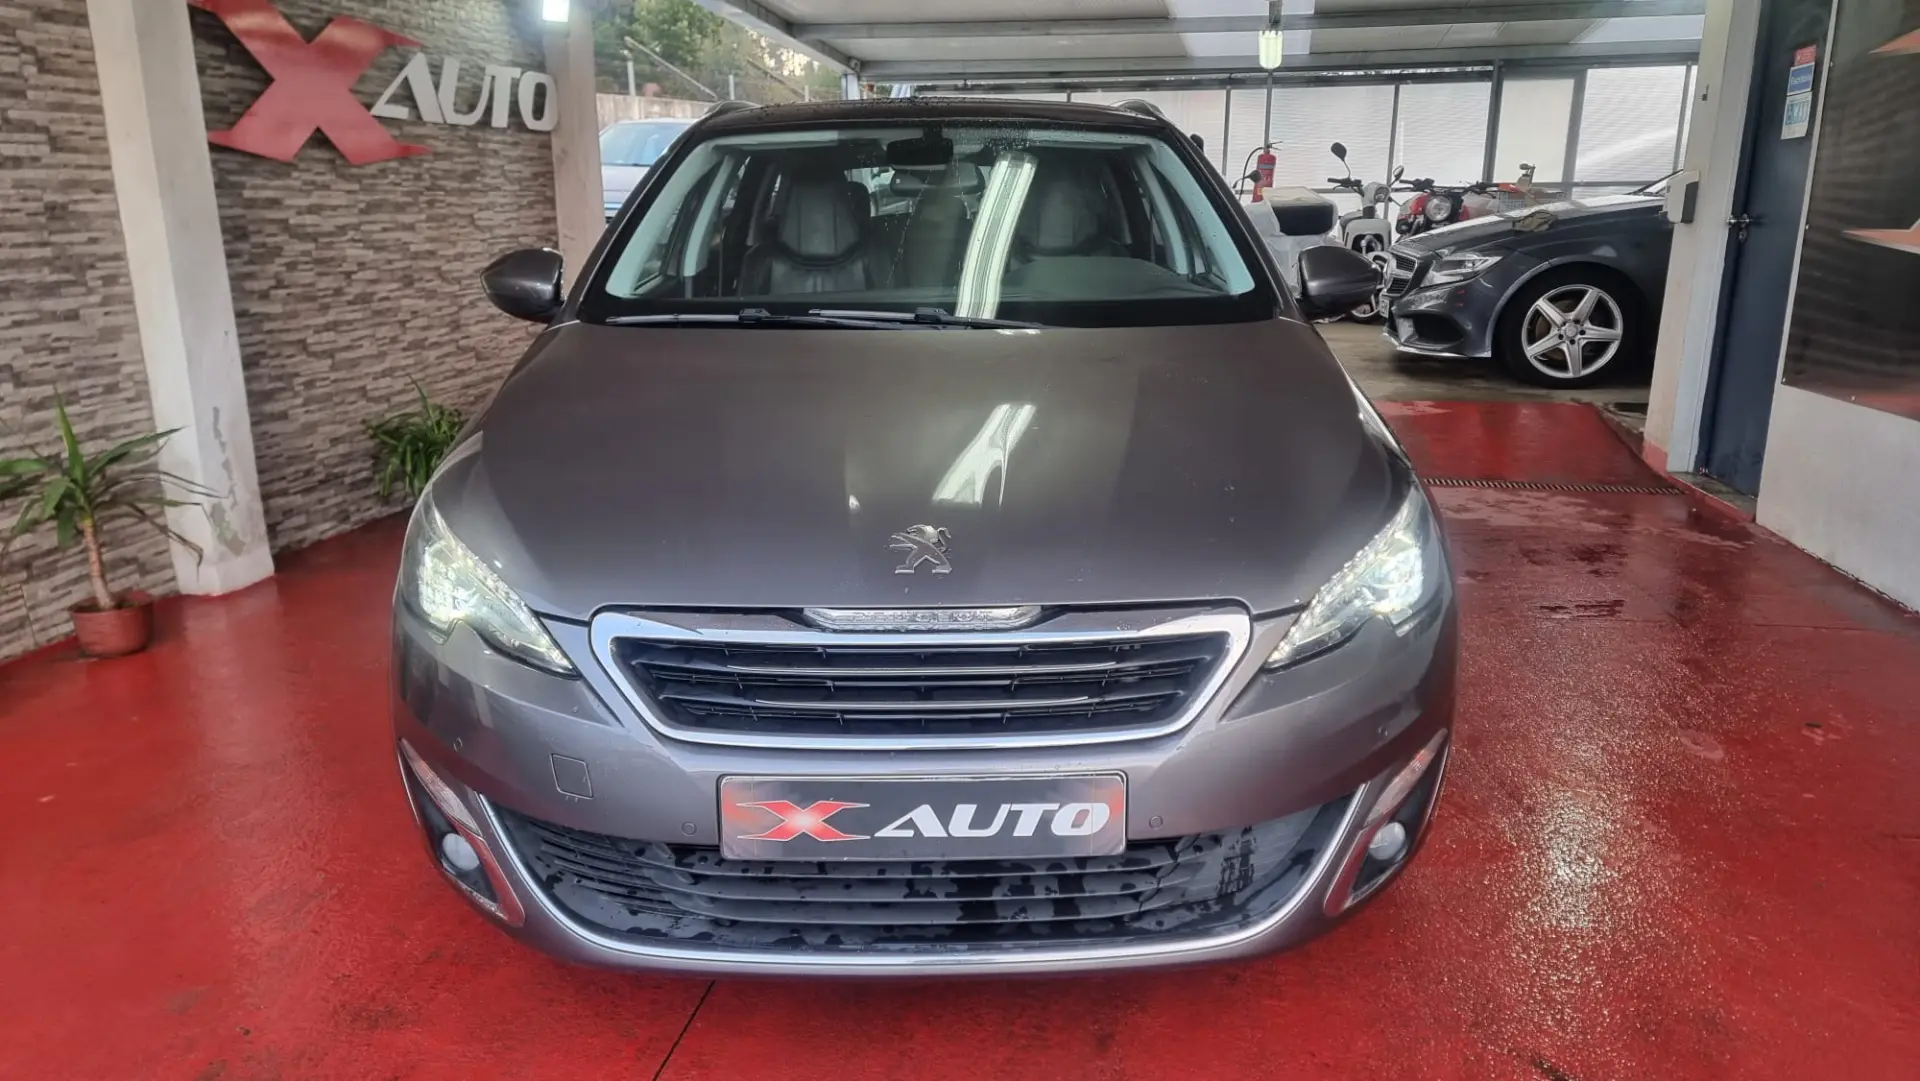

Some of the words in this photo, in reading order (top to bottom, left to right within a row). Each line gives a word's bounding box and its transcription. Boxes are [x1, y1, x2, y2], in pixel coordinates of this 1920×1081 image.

[188, 0, 431, 165] X
[369, 51, 559, 132] AUTO
[736, 799, 870, 842] X
[874, 802, 1110, 837] AUTO
